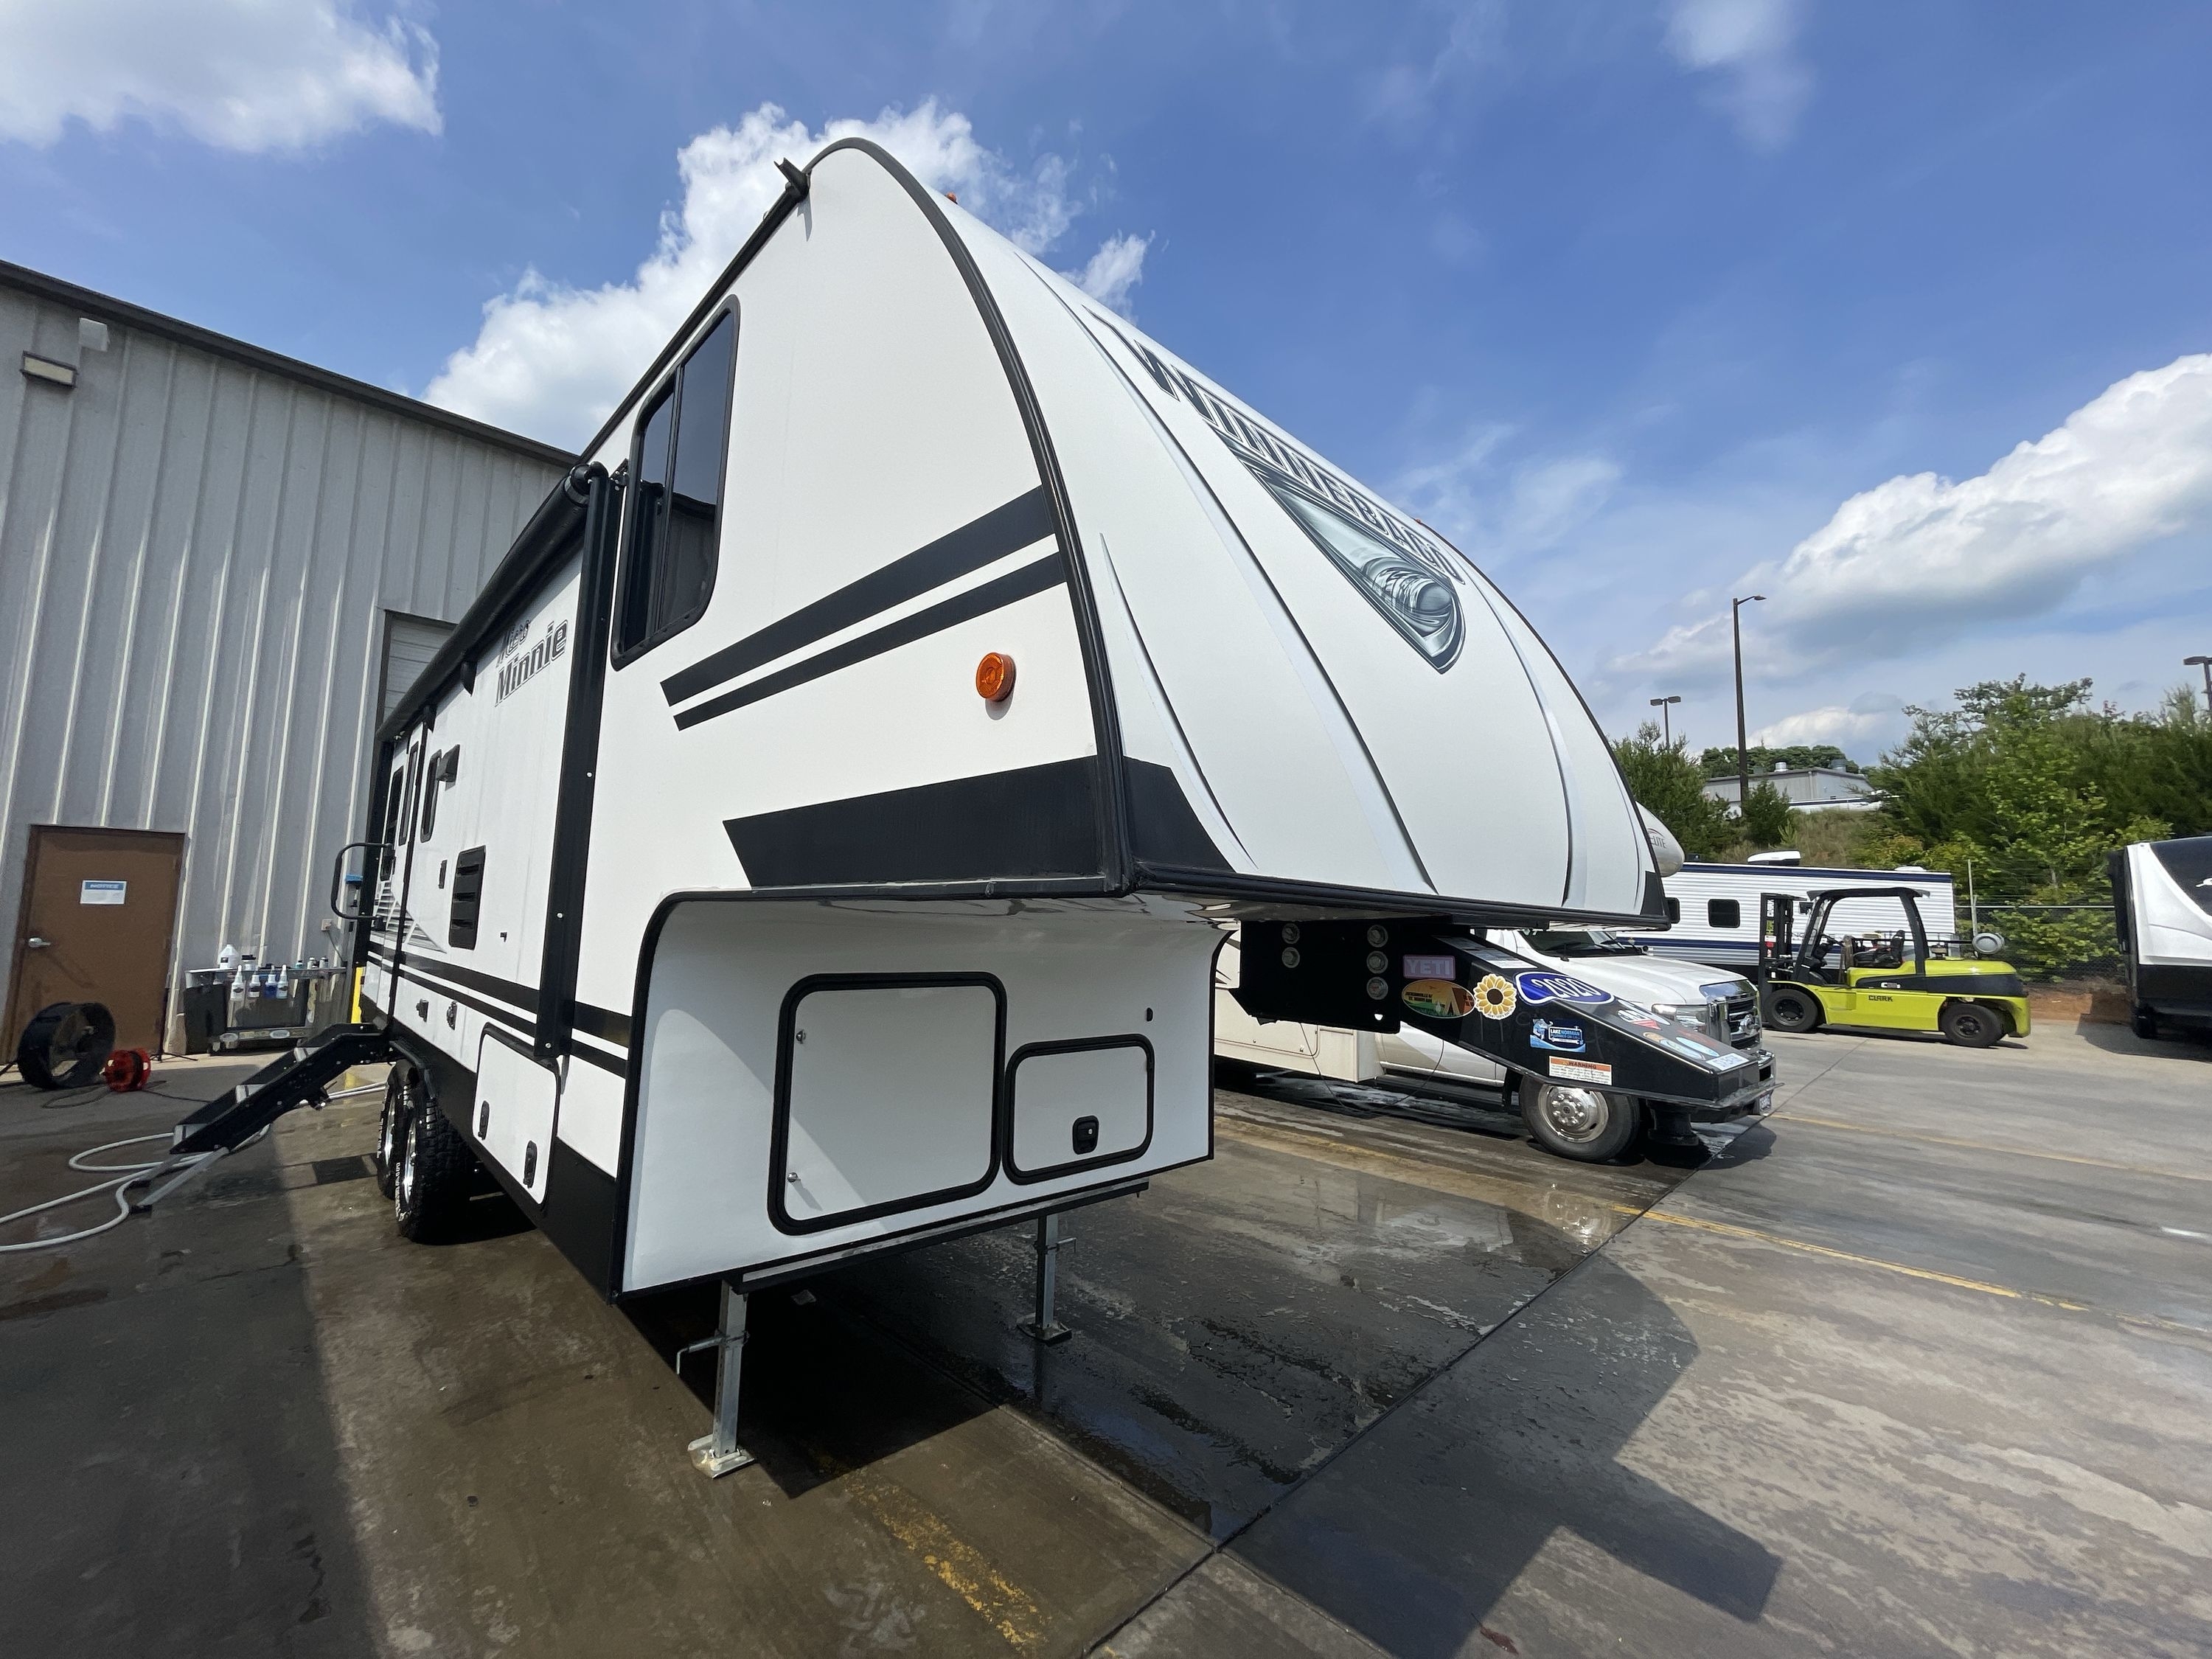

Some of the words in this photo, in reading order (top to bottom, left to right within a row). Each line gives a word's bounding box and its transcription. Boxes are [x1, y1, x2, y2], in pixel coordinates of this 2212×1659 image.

[1082, 305, 1465, 585] WINNEBAGO
[495, 619, 568, 707] Minnie
[1405, 959, 1450, 975] YETI
[1568, 1061, 1596, 1069] WARNING
